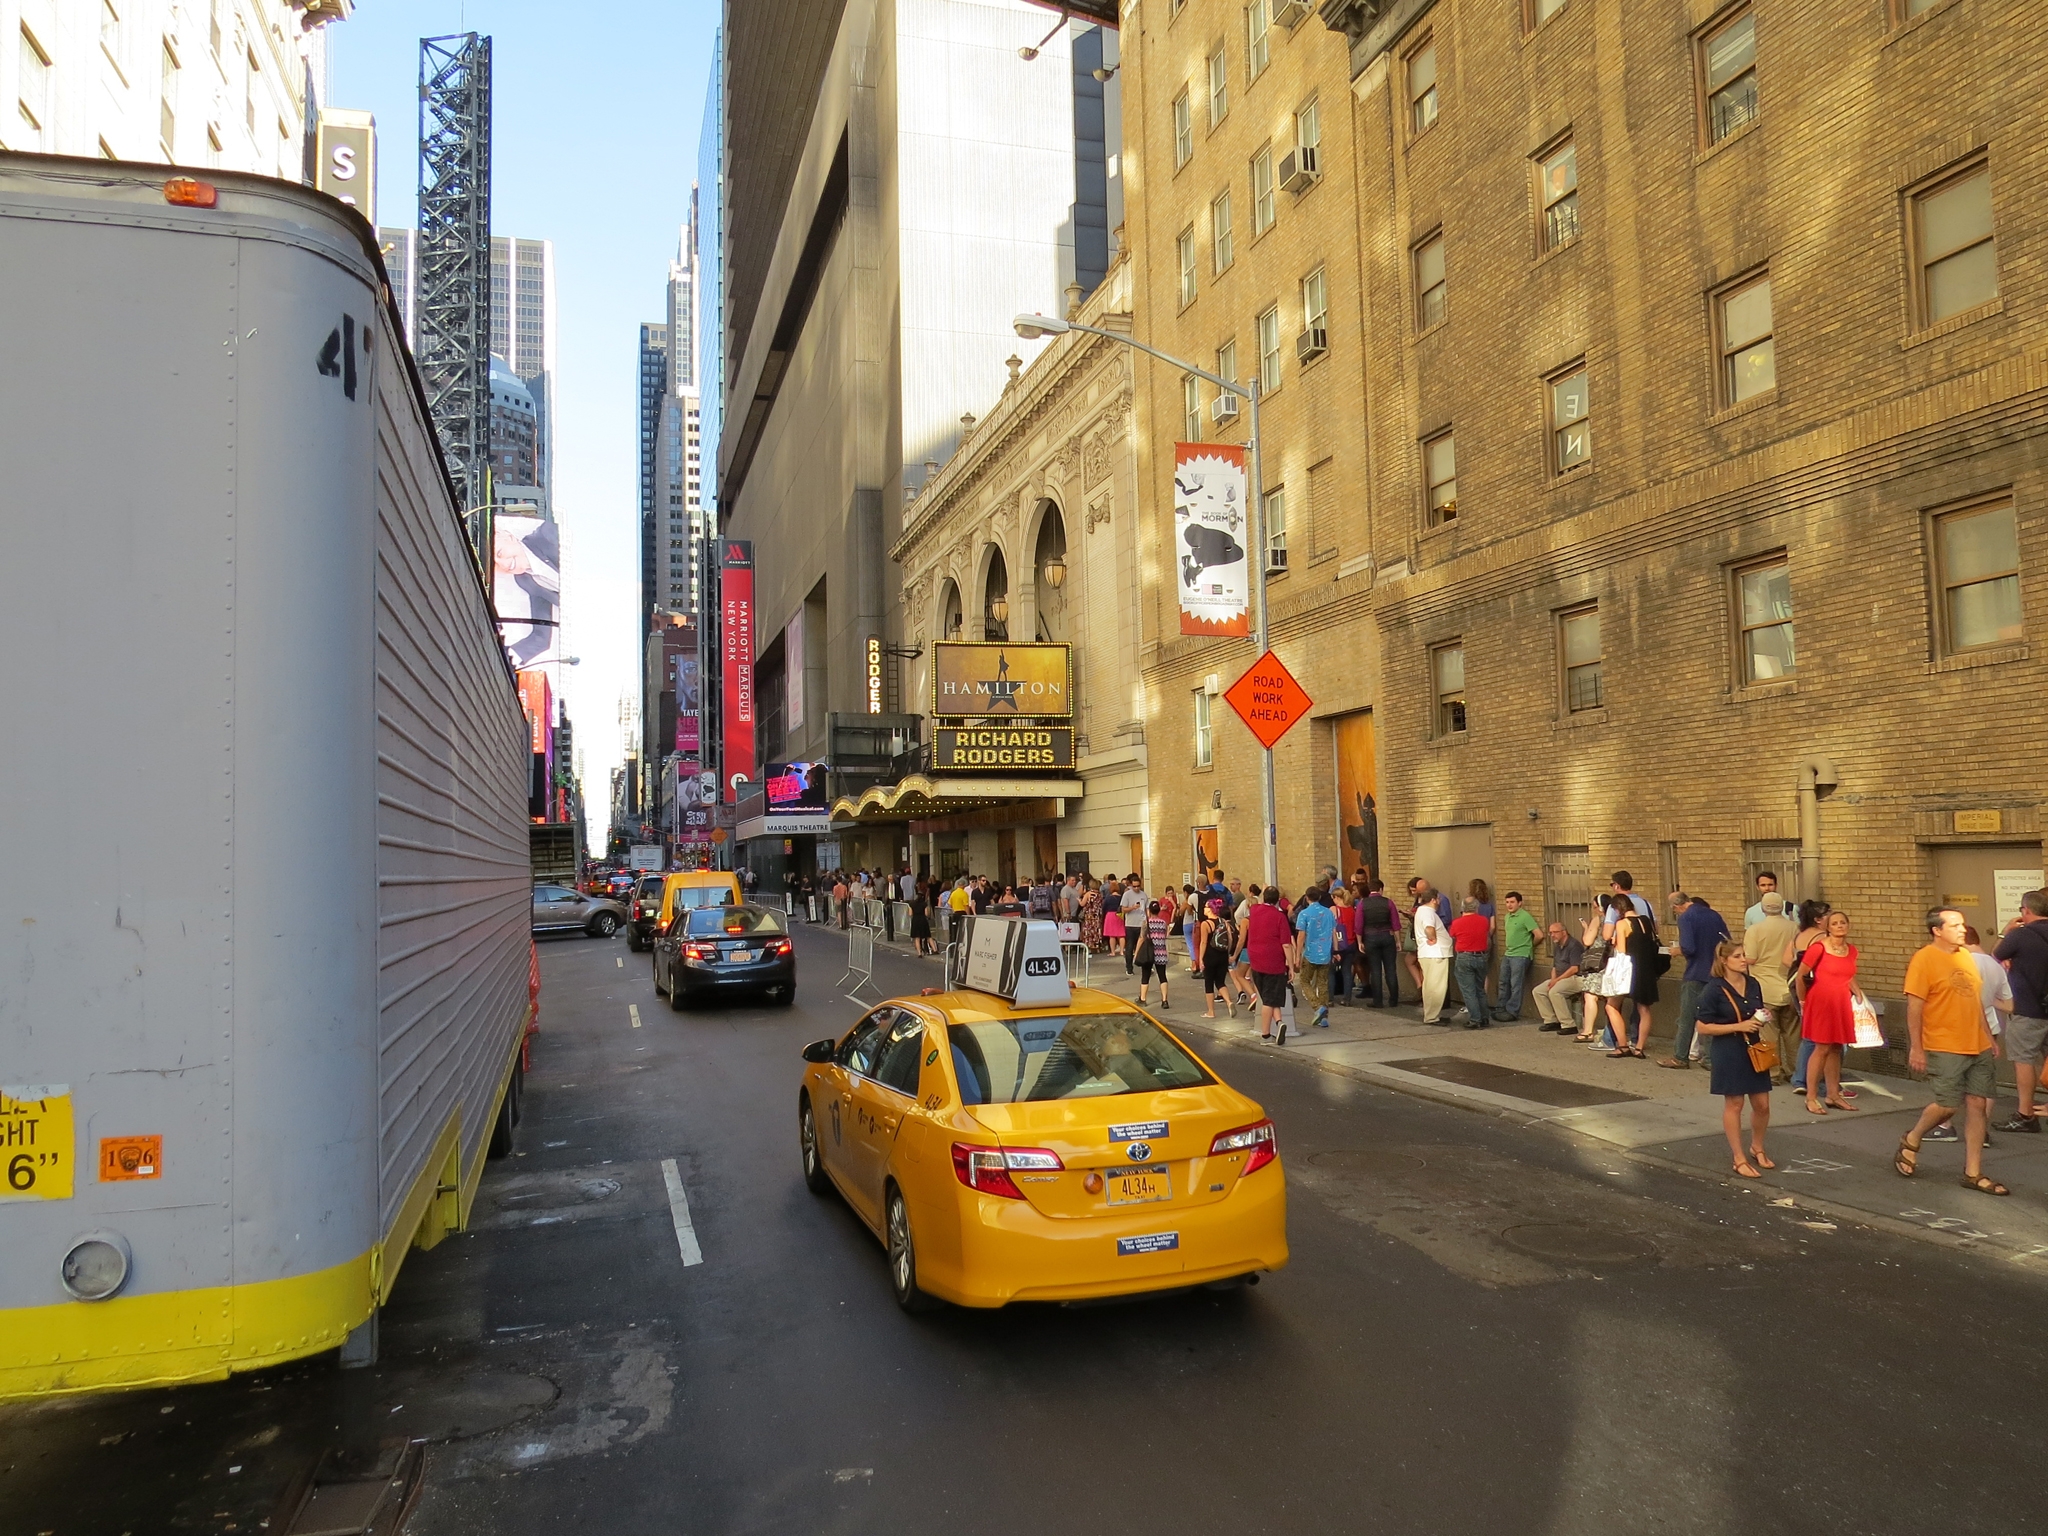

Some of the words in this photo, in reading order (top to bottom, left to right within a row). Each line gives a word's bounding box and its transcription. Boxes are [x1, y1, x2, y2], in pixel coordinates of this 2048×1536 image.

[728, 601, 736, 625] NEW
[740, 601, 748, 661] MARRIOTT
[728, 631, 736, 661] YORK
[943, 682, 1061, 695] HAMILTON
[1253, 676, 1284, 689] ROAD
[740, 666, 749, 720] MARQUIS
[1253, 692, 1283, 705] WORK
[1250, 709, 1288, 722] AHEAD
[956, 732, 1052, 747] RICHARD
[953, 749, 1055, 764] RODGERS
[1959, 813, 1995, 821] IMPERIAL
[1028, 960, 1057, 974] 4L34
[1147, 1122, 1165, 1130] behind
